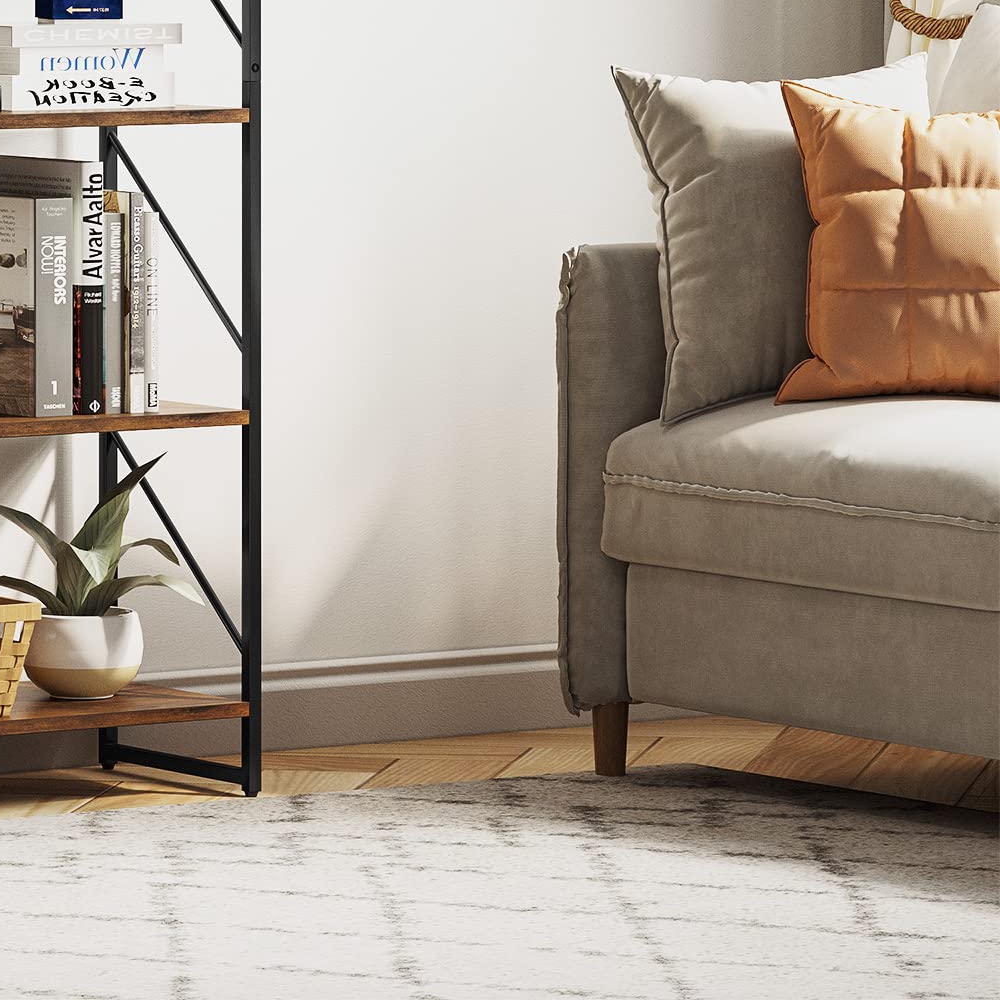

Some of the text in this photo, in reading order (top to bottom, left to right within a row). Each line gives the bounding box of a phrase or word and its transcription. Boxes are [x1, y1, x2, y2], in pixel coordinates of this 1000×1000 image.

[133, 204, 143, 242] Picasso
[40, 235, 54, 275] NOW!
[53, 235, 67, 306] INTERIORS
[133, 243, 144, 283] Guitars
[50, 380, 58, 396] 1
